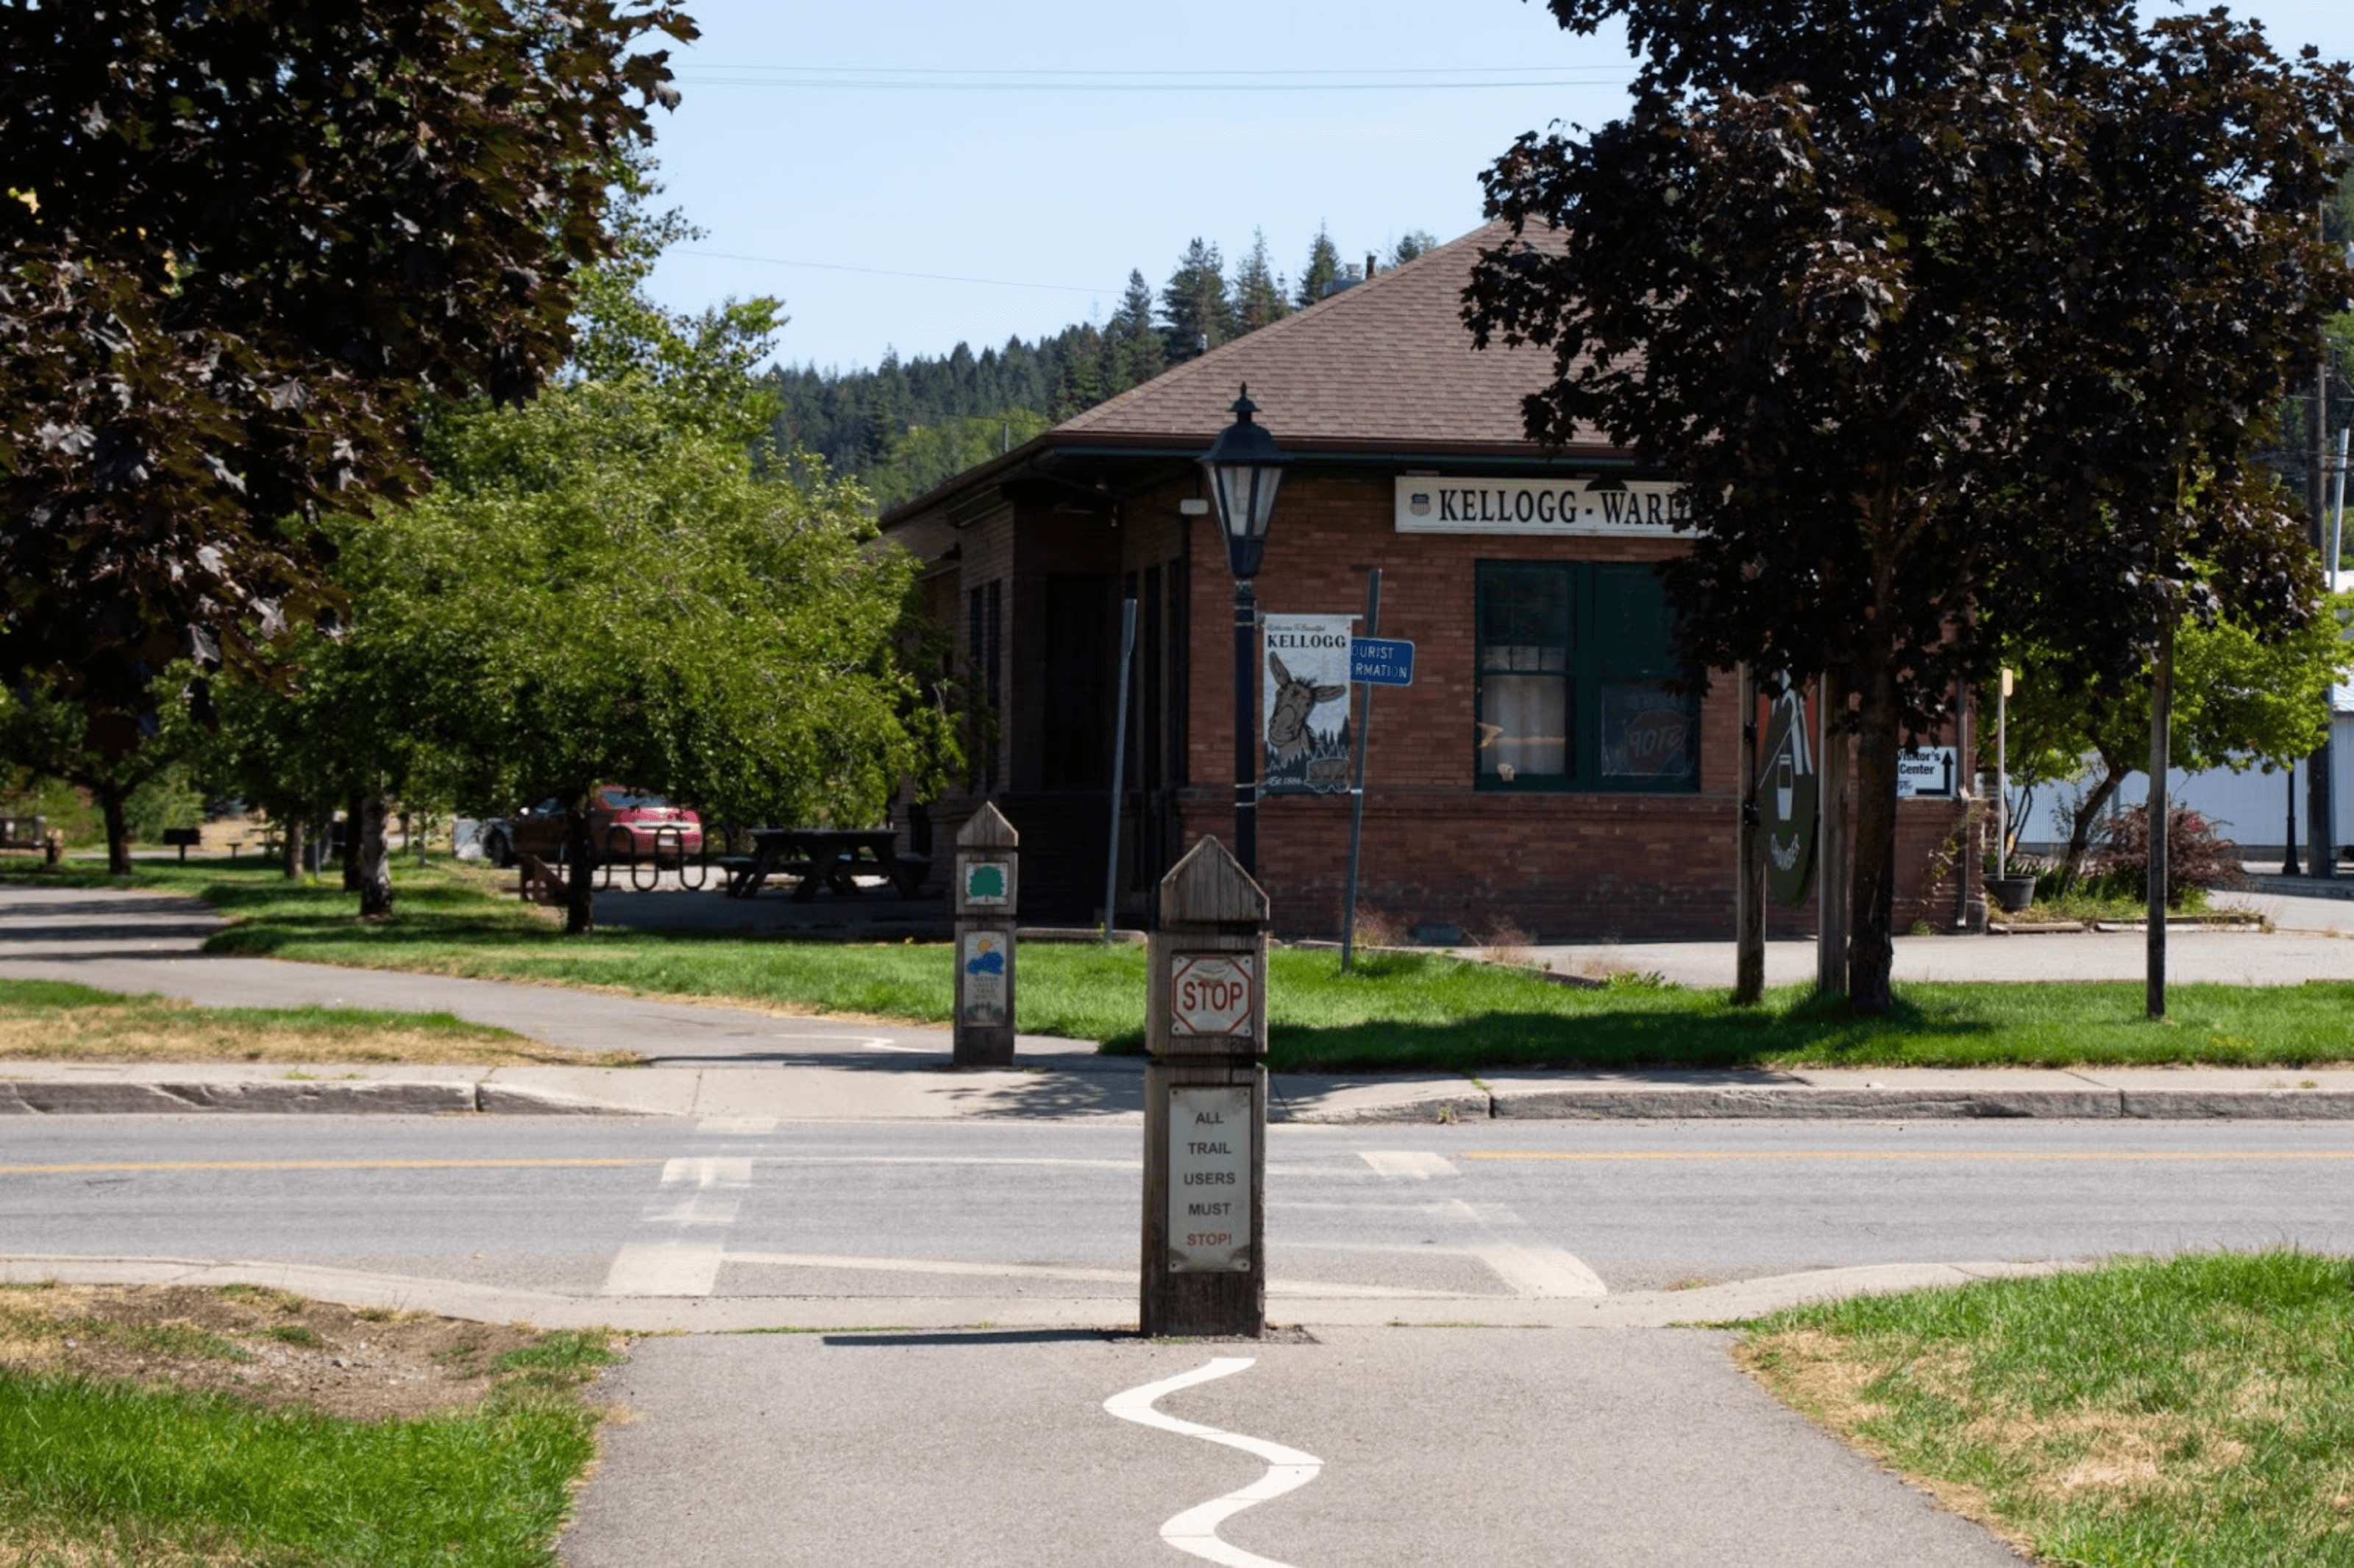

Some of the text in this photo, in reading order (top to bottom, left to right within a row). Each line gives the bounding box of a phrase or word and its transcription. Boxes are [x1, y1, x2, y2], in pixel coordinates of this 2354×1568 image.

[1438, 489, 1577, 524] KELLOGG
[1267, 634, 1346, 649] KELLOGG
[1351, 662, 1407, 678] RMATION
[1899, 763, 1935, 774] Center
[1182, 980, 1243, 1011] STOP
[1195, 1112, 1224, 1125] ALL
[1187, 1142, 1231, 1155] TRAIL
[1184, 1172, 1236, 1186] USERS
[1188, 1202, 1231, 1216] MUST
[1187, 1233, 1232, 1247] STOP!
